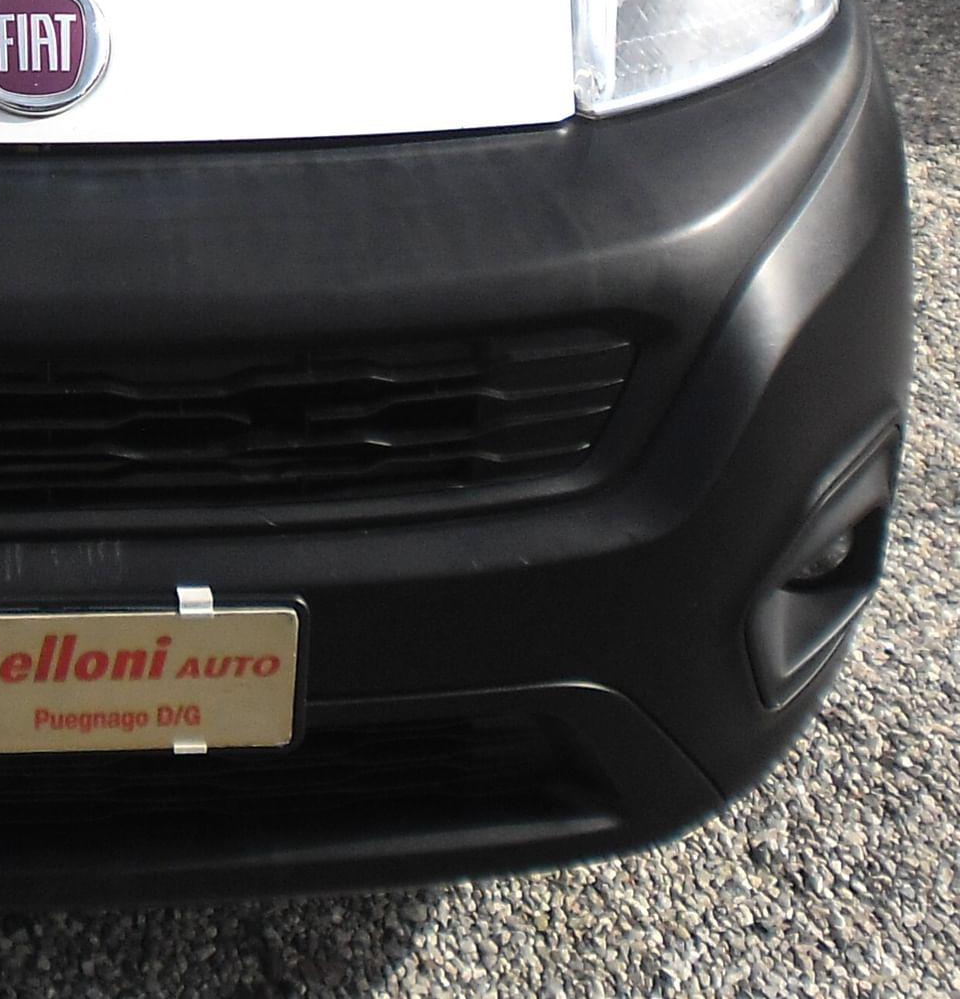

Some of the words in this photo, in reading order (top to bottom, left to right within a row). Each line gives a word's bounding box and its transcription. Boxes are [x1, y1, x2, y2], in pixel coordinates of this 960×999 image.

[176, 655, 281, 680] AUTO
[34, 706, 148, 733] Puegnago
[157, 705, 202, 727] D/G
